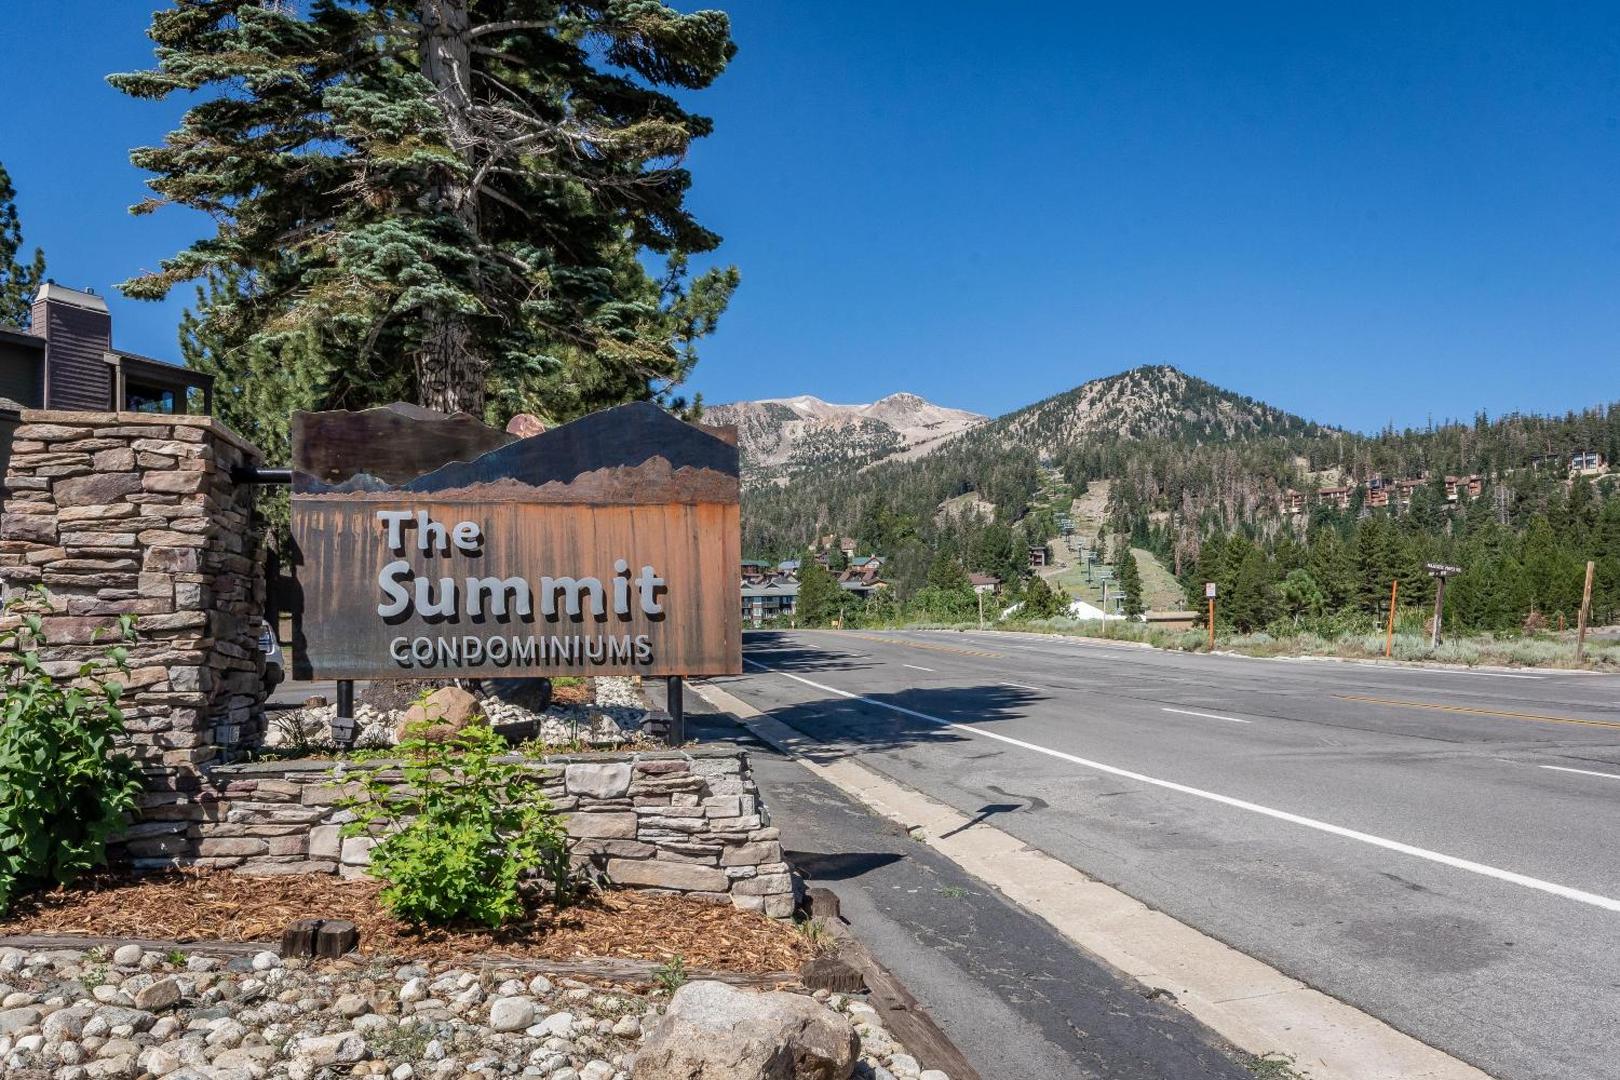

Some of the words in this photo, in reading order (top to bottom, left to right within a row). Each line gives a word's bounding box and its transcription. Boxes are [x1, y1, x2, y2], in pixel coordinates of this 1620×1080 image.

[376, 510, 482, 551] The
[377, 558, 665, 619] Summit
[389, 634, 652, 663] CONDOMINIUMS
